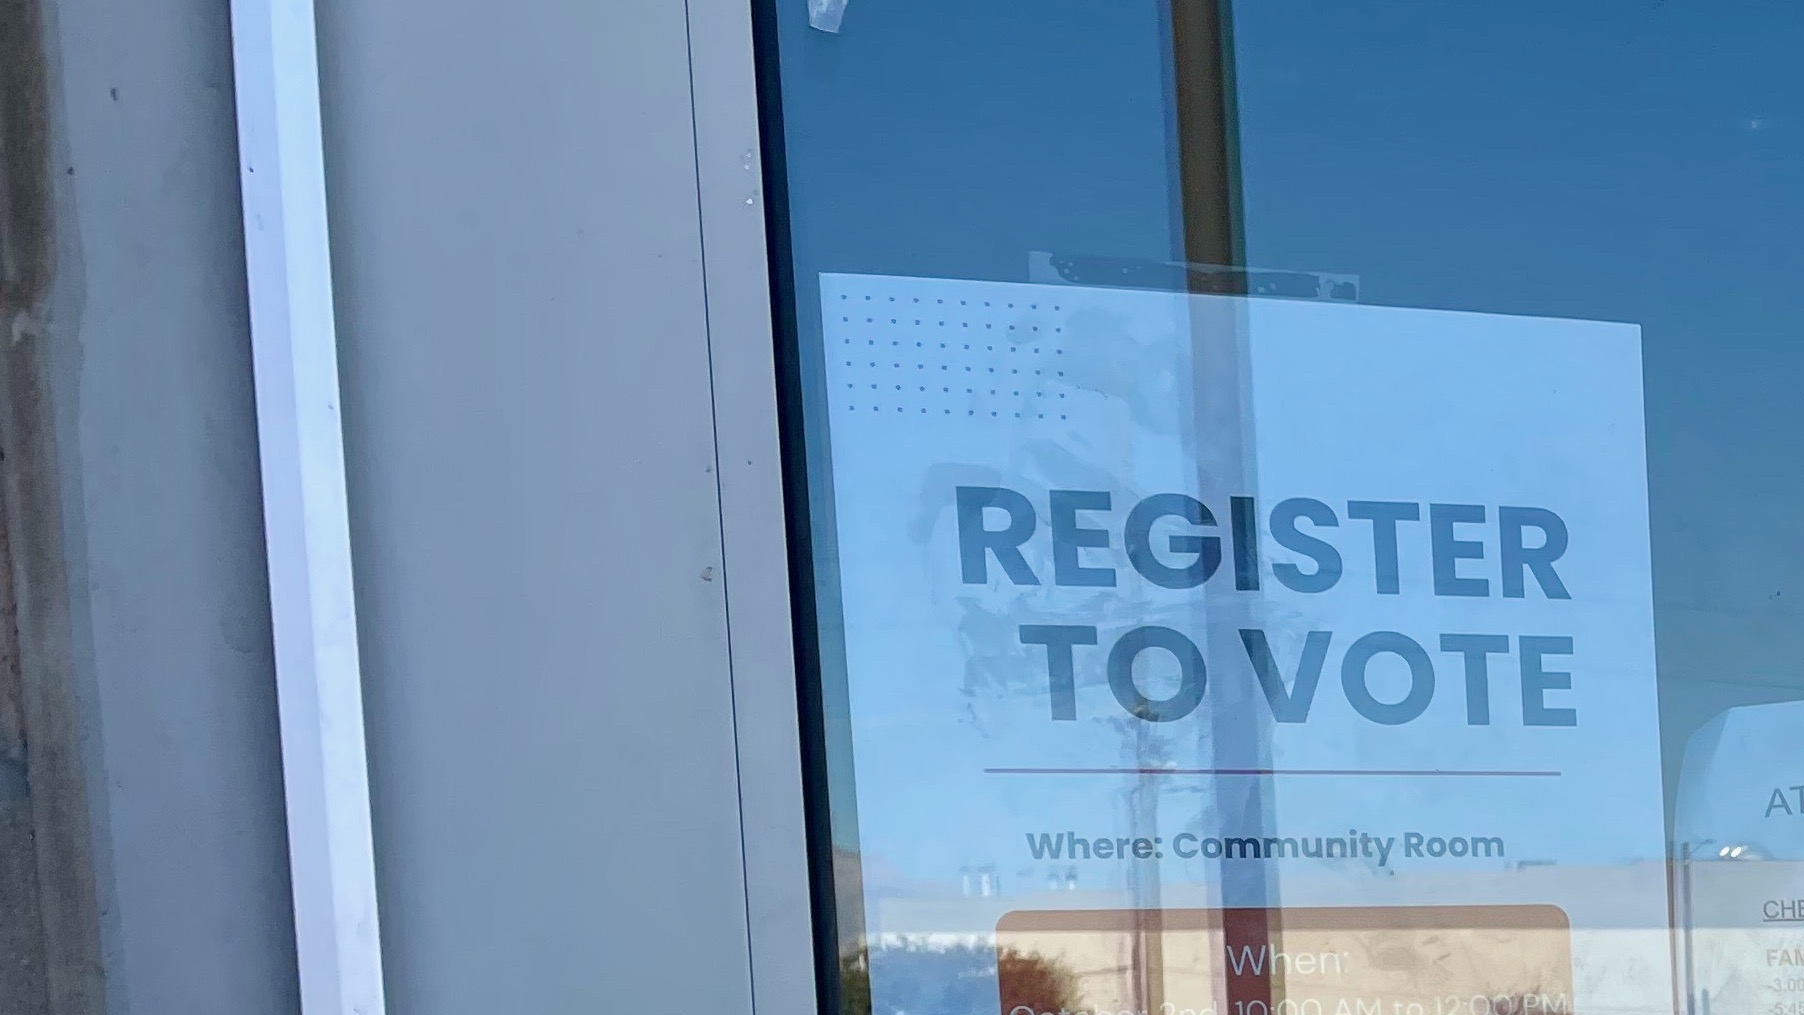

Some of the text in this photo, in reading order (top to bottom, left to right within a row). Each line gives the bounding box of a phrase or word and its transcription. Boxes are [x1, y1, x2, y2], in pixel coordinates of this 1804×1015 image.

[955, 486, 1572, 600] REGISTER
[1019, 624, 1578, 727] TO VOTE
[1025, 828, 1505, 867] Where: Community Room
